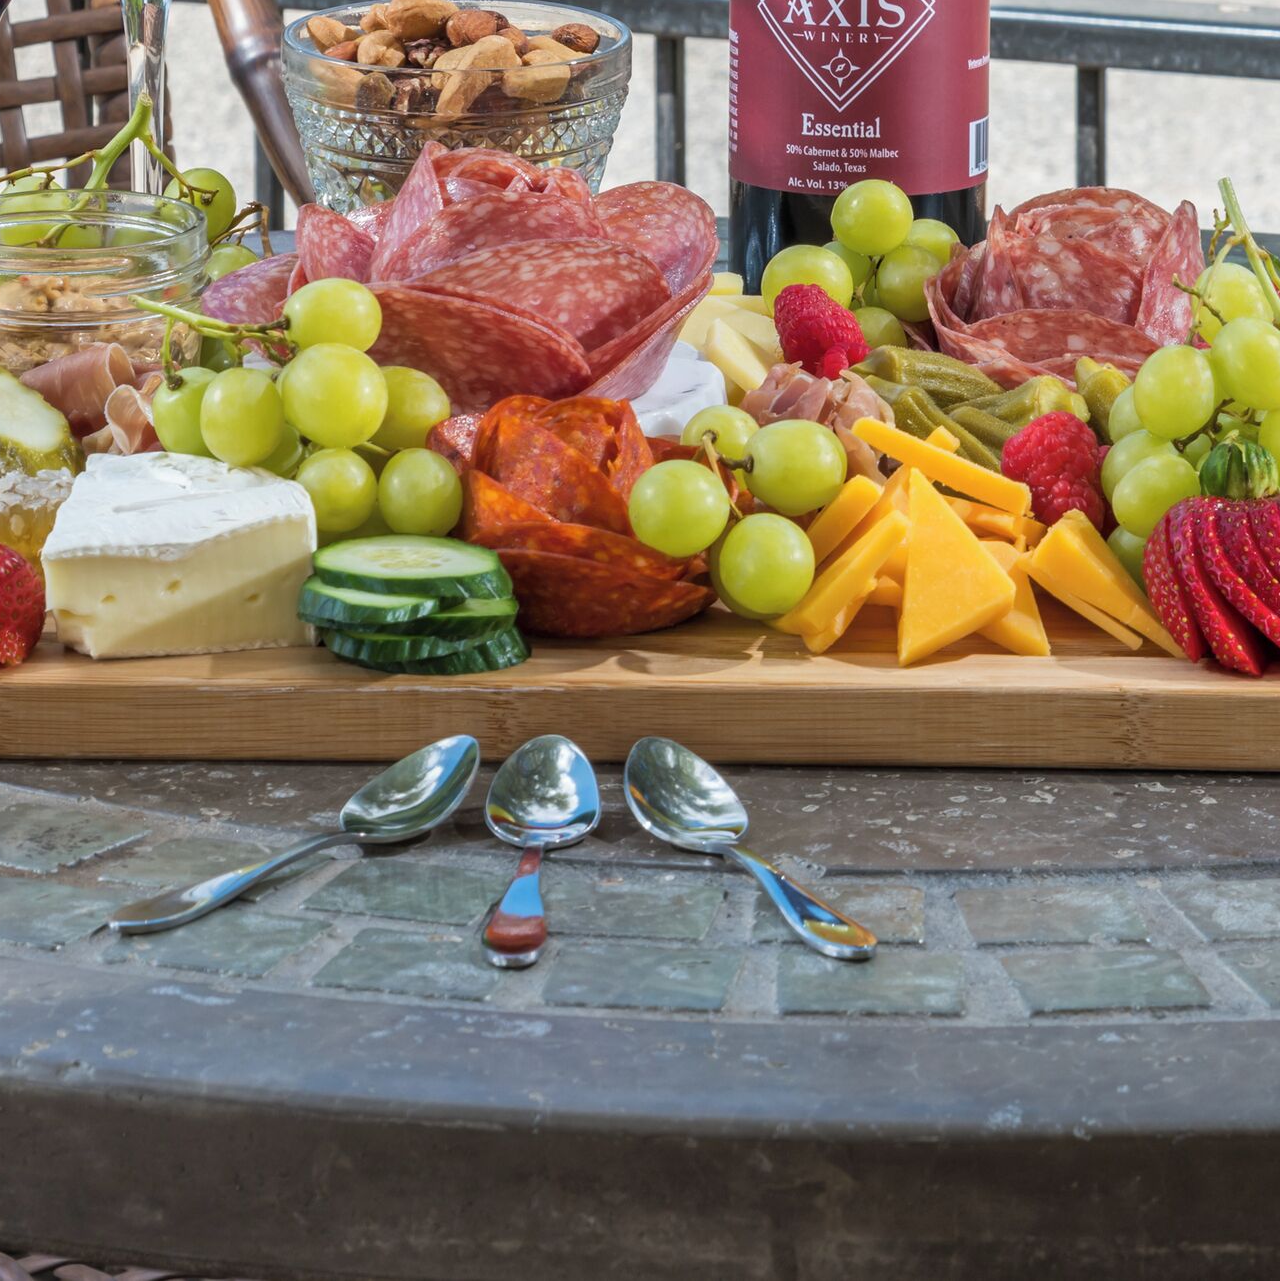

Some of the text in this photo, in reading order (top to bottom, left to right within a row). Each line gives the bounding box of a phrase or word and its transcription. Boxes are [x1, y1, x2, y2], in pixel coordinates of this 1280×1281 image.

[803, 30, 880, 44] WINERY
[801, 112, 881, 138] Essential
[786, 144, 899, 159] 50% Cabernet & 50% Malbec
[813, 161, 867, 174] Salado, Texas
[788, 177, 849, 191] Alc. Vol. 13%
